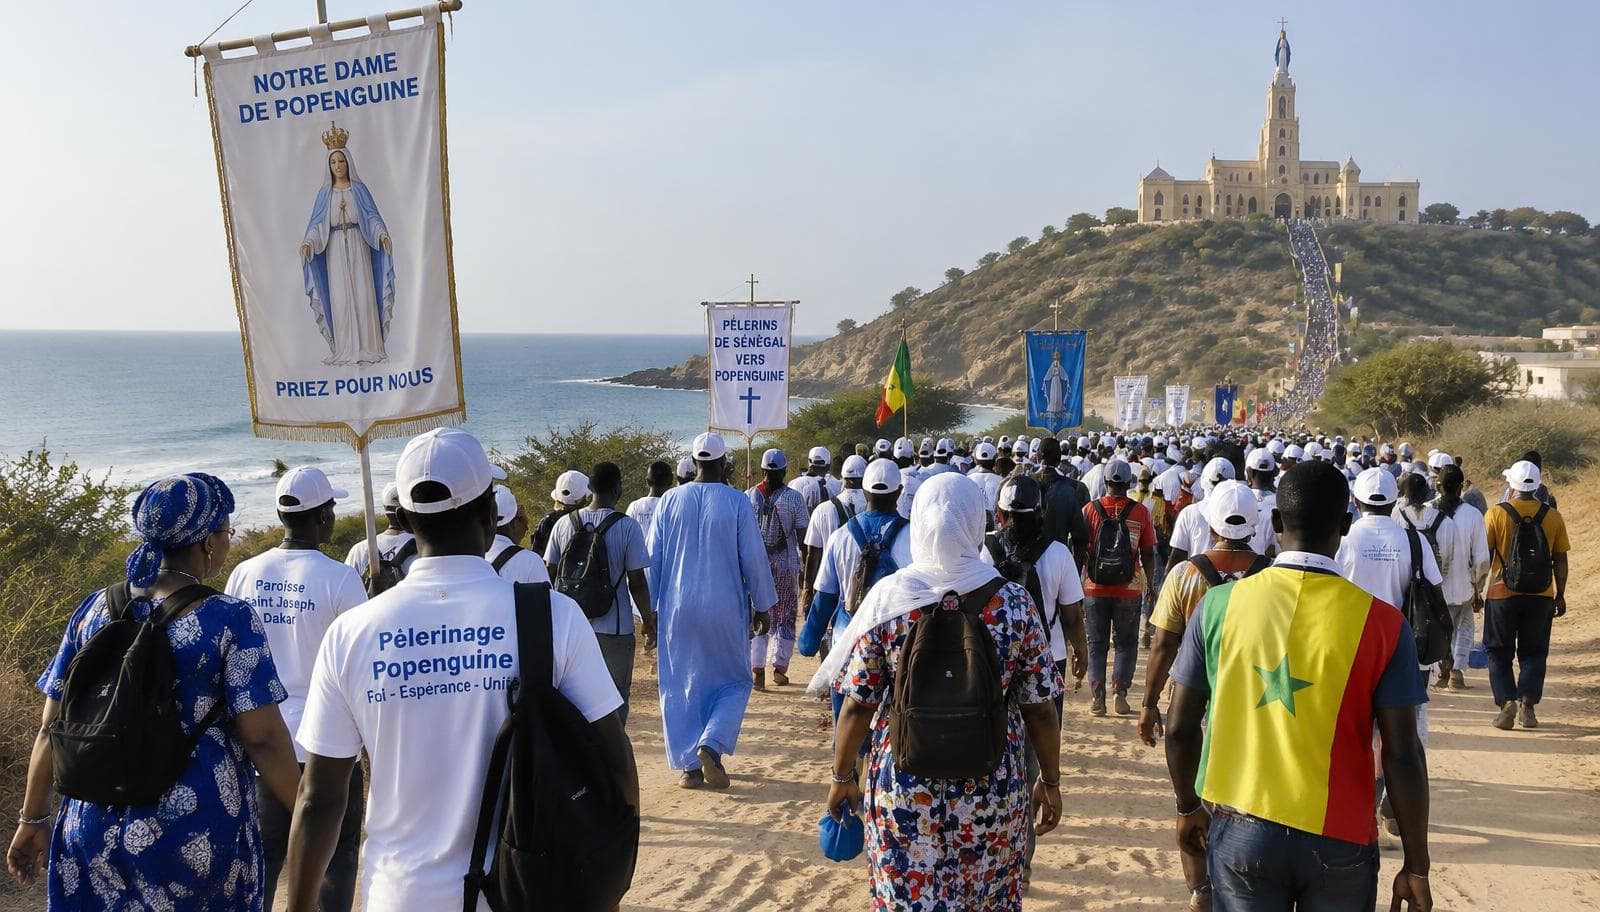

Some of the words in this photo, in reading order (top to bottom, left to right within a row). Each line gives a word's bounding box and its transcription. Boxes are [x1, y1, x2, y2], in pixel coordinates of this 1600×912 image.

[253, 63, 329, 94] NOTRE
[334, 52, 398, 81] DAME
[239, 102, 270, 123] DE
[275, 77, 419, 119] POPENGUINE
[723, 314, 778, 331] PÉLERINS
[714, 337, 730, 348] DE
[733, 334, 786, 348] SÉNÉGAL
[736, 354, 765, 365] VERS
[276, 380, 329, 397] PRIEZ
[335, 376, 384, 396] POUR
[388, 367, 434, 391] NOUS
[715, 370, 785, 382] POPENGUINE
[256, 579, 305, 593] Paroisse
[263, 612, 296, 625] Dakar
[372, 649, 513, 681] Popenguine
[367, 688, 387, 704] Foi
[400, 681, 471, 700] Espérance
